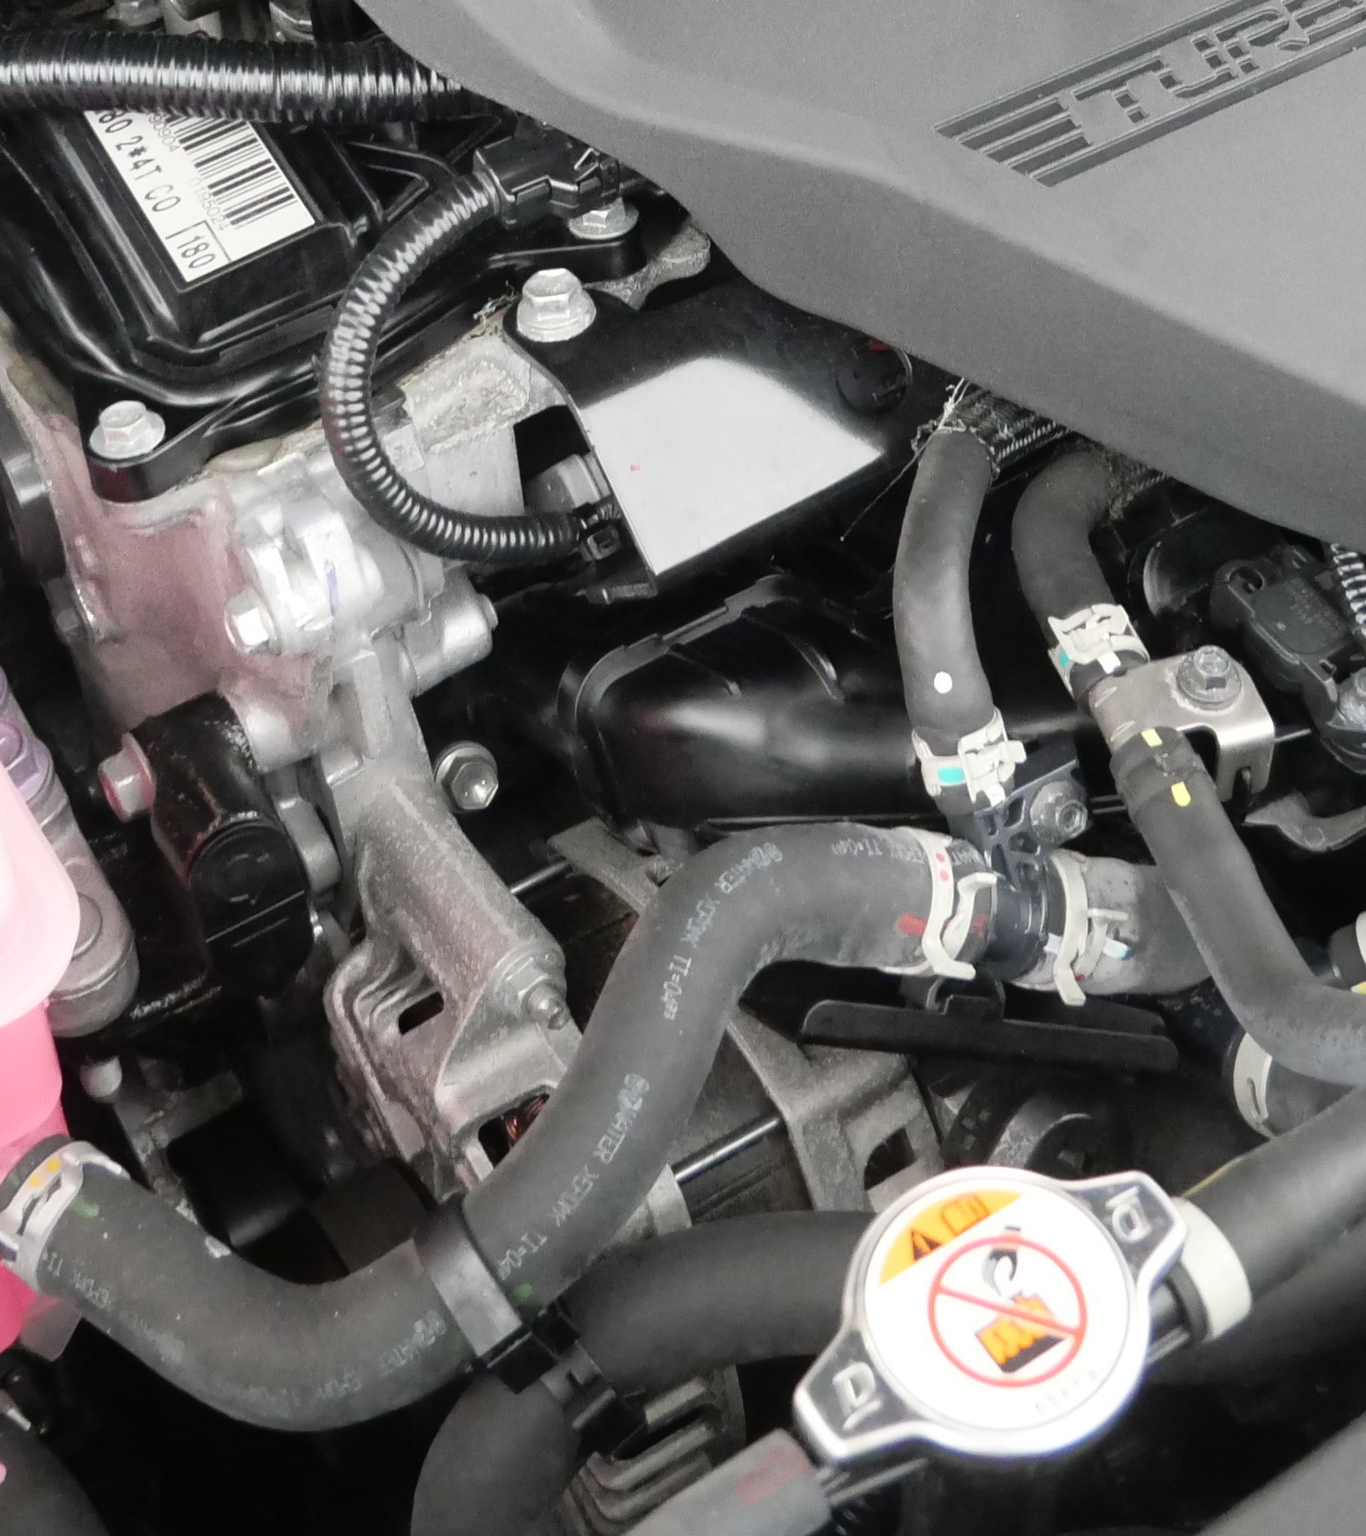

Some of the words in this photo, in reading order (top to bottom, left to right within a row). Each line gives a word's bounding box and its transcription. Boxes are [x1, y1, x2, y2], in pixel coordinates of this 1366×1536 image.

[96, 112, 133, 134] 80
[146, 114, 184, 153] 90904
[177, 235, 216, 269] 180
